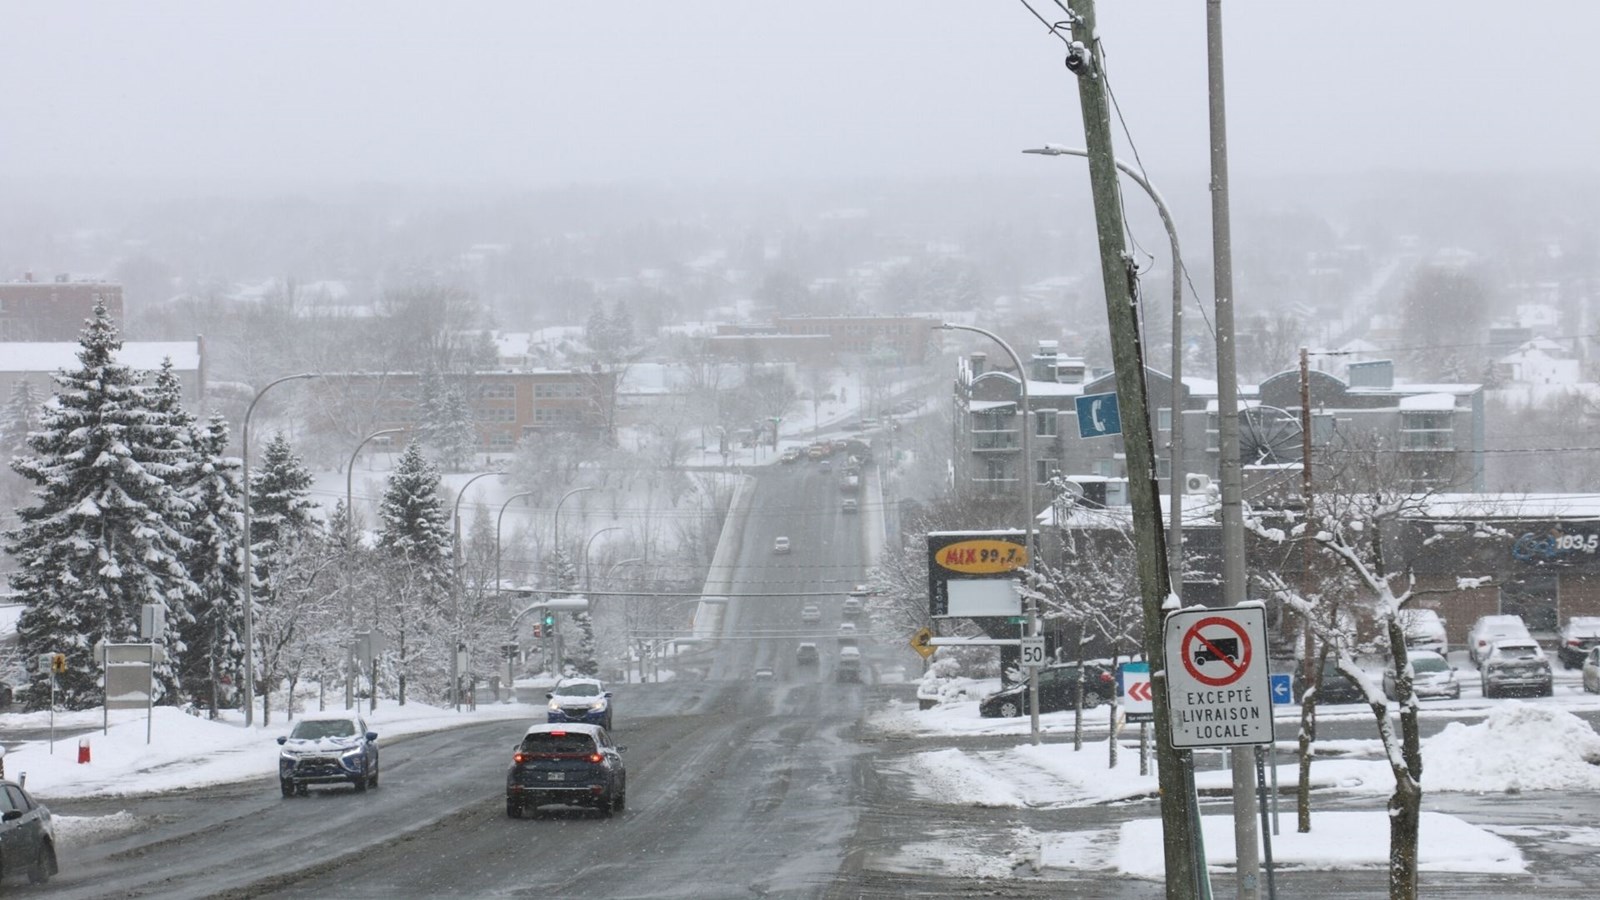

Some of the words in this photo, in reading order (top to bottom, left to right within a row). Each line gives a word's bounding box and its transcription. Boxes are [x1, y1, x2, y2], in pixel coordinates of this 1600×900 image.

[1556, 534, 1599, 552] 103,5
[945, 548, 977, 565] MIX
[1024, 646, 1042, 662] 50
[1187, 686, 1253, 705] EXCEPTÉ
[1182, 706, 1260, 723] LIVRAISON
[1196, 724, 1249, 739] LOCALE
